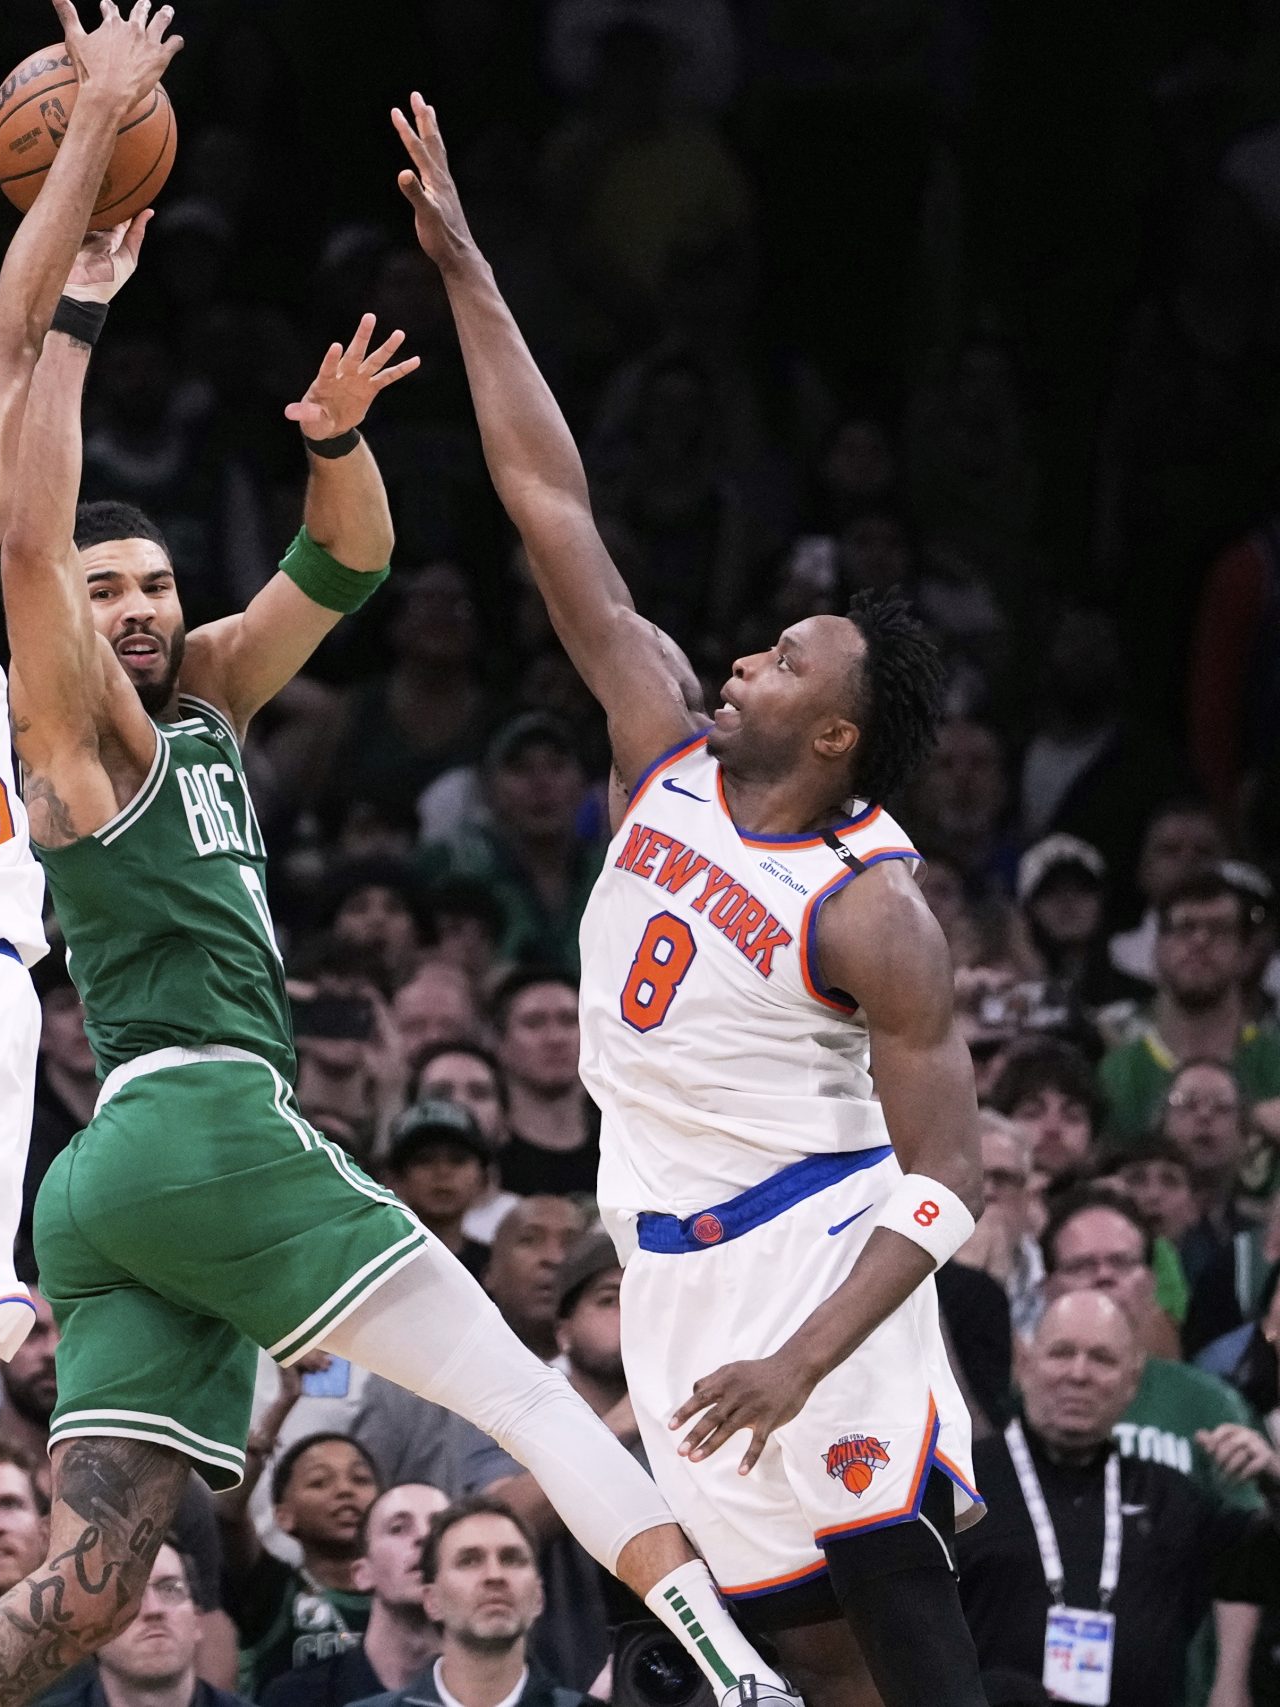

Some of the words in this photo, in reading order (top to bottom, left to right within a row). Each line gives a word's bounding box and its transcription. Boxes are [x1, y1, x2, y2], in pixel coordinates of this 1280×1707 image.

[836, 845, 851, 860] 12
[759, 861, 780, 878] abu
[779, 873, 809, 896] dhabi
[615, 822, 707, 896] NEW
[690, 865, 792, 980] YORK
[620, 910, 697, 1034] 8
[913, 1200, 939, 1227] 8
[827, 1437, 890, 1476] KNICKS
